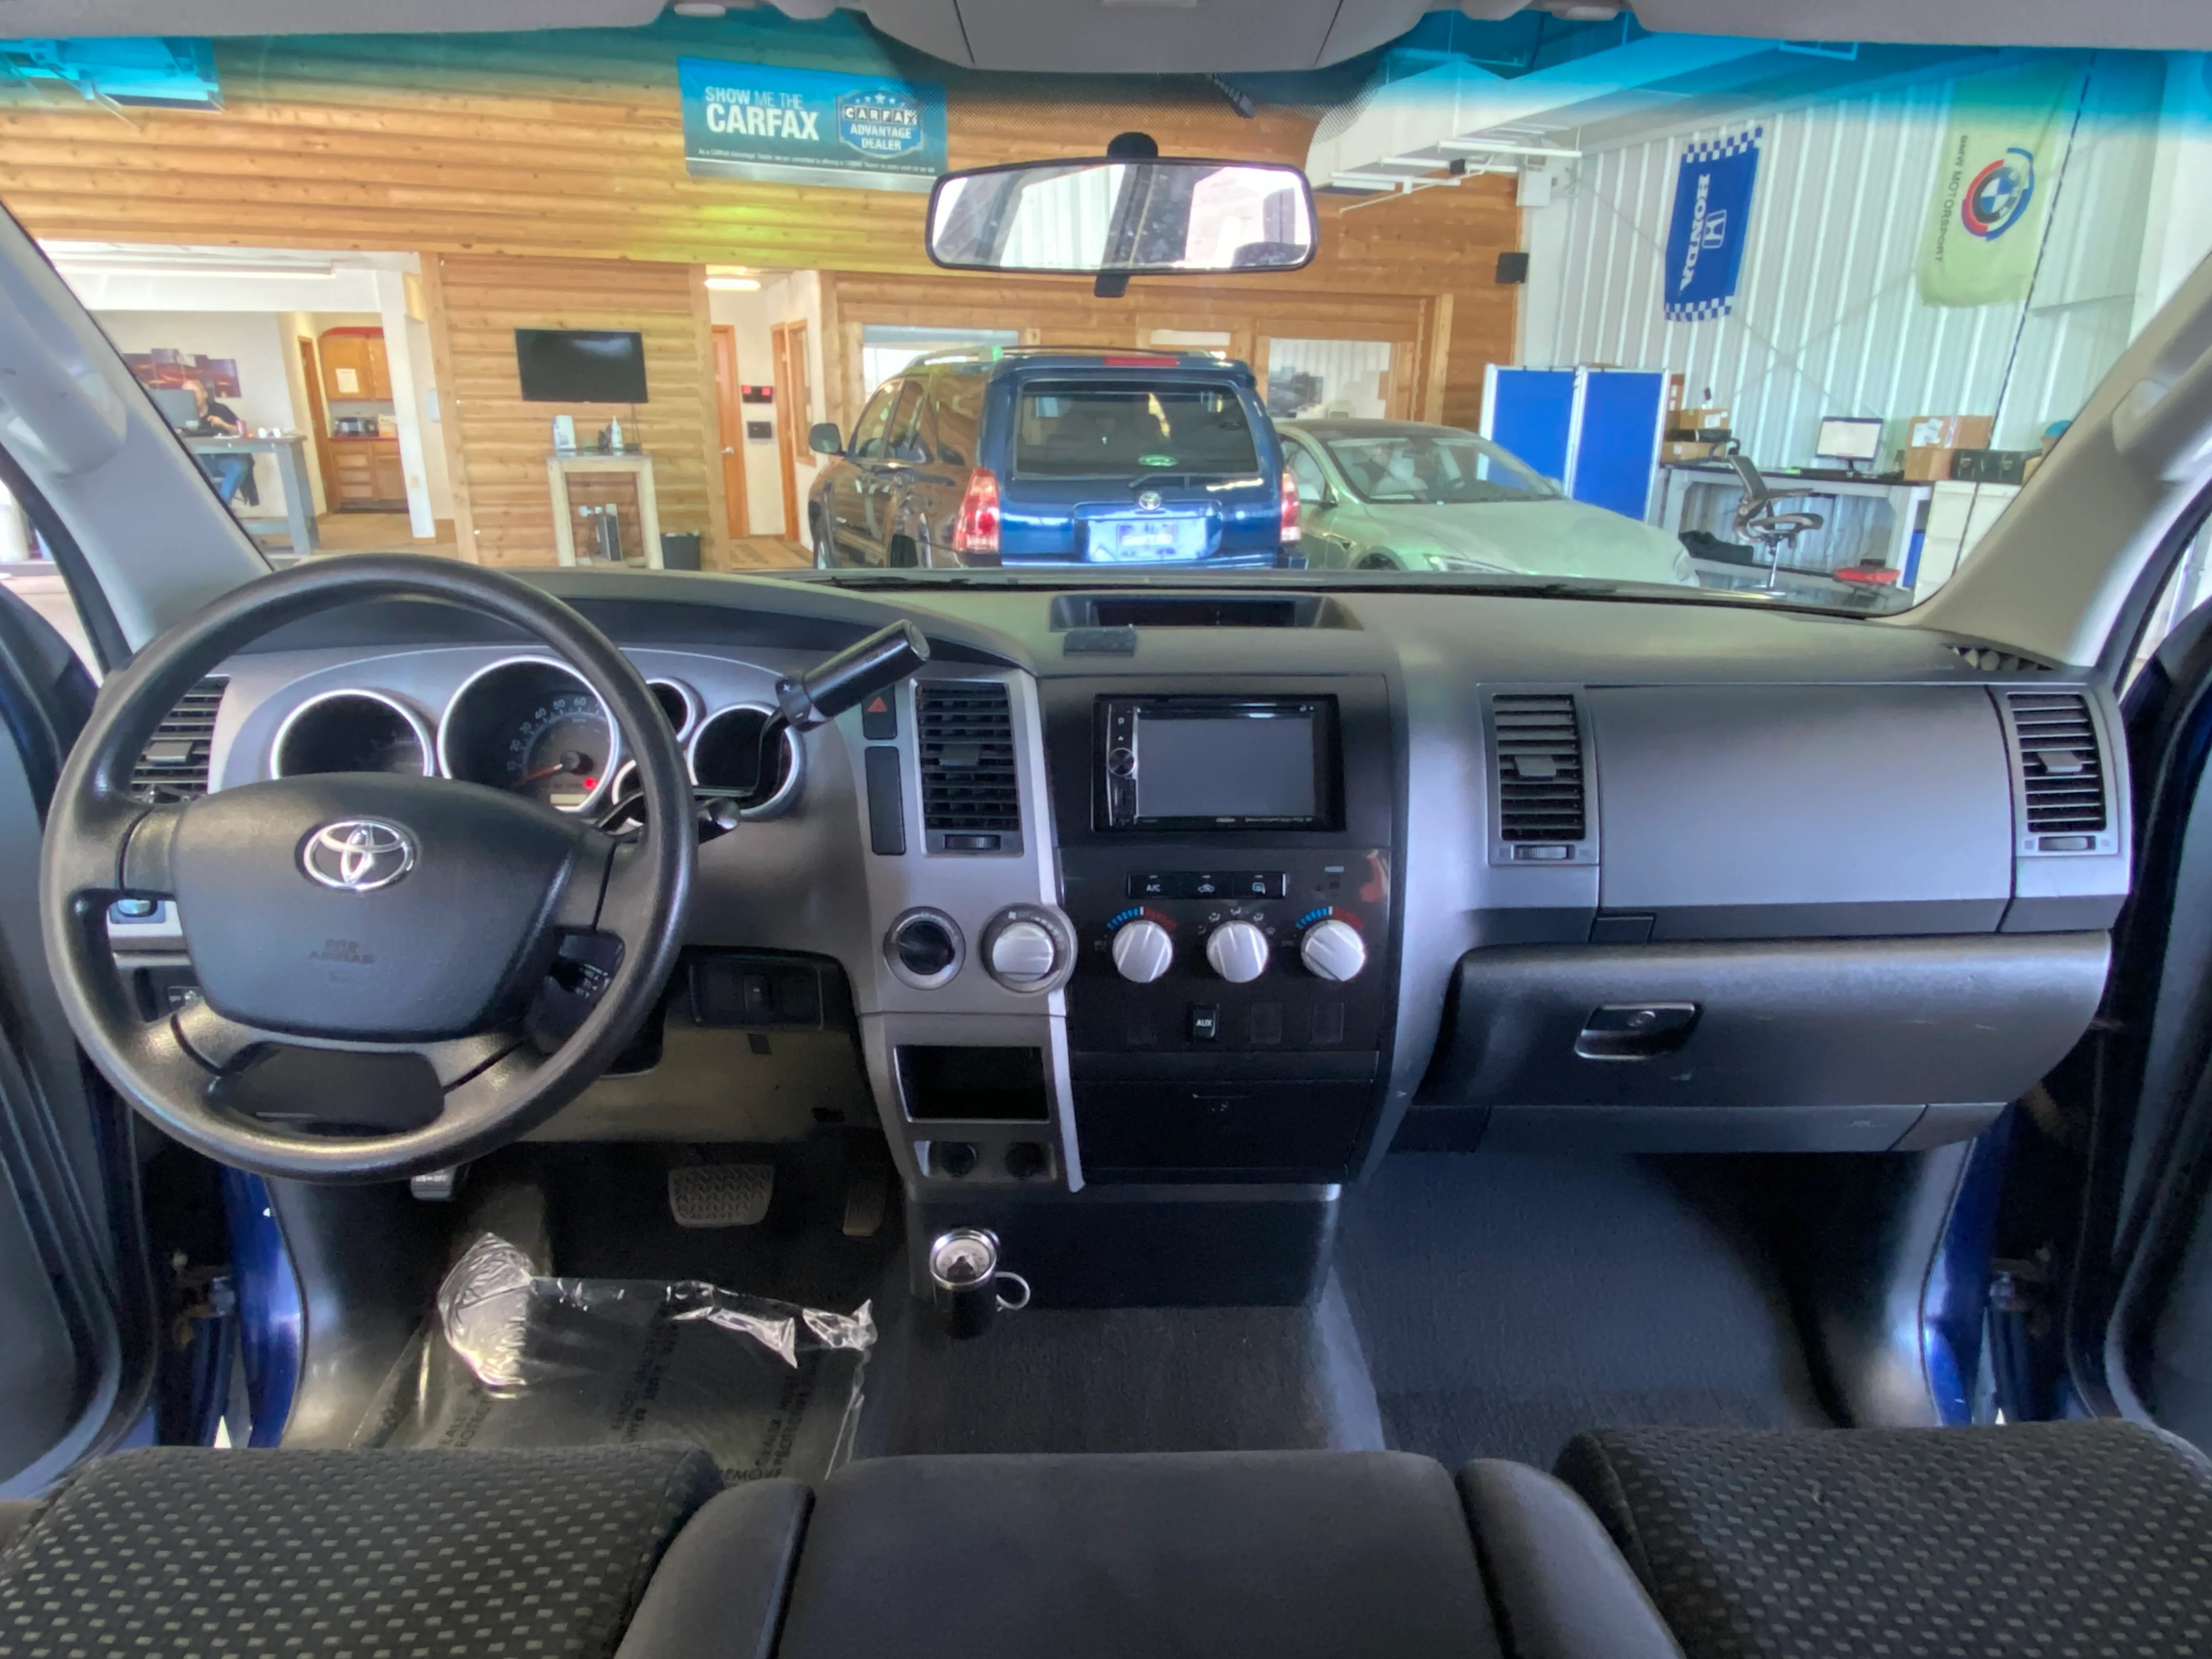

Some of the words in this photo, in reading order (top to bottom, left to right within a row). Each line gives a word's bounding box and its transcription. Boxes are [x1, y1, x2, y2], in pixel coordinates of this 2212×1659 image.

[705, 86, 750, 105] SHOW
[754, 90, 776, 107] ME
[779, 93, 804, 110] THE
[706, 102, 820, 141] CARFAX
[845, 107, 917, 125] CARFAX
[851, 123, 911, 139] ADVANTAGE
[861, 137, 902, 151] DEALER
[1955, 135, 1968, 167] BMW
[1935, 171, 1962, 262] MOTORSPORT
[1678, 174, 1711, 291] HONDA
[553, 699, 566, 710] 50
[573, 697, 587, 707] 60
